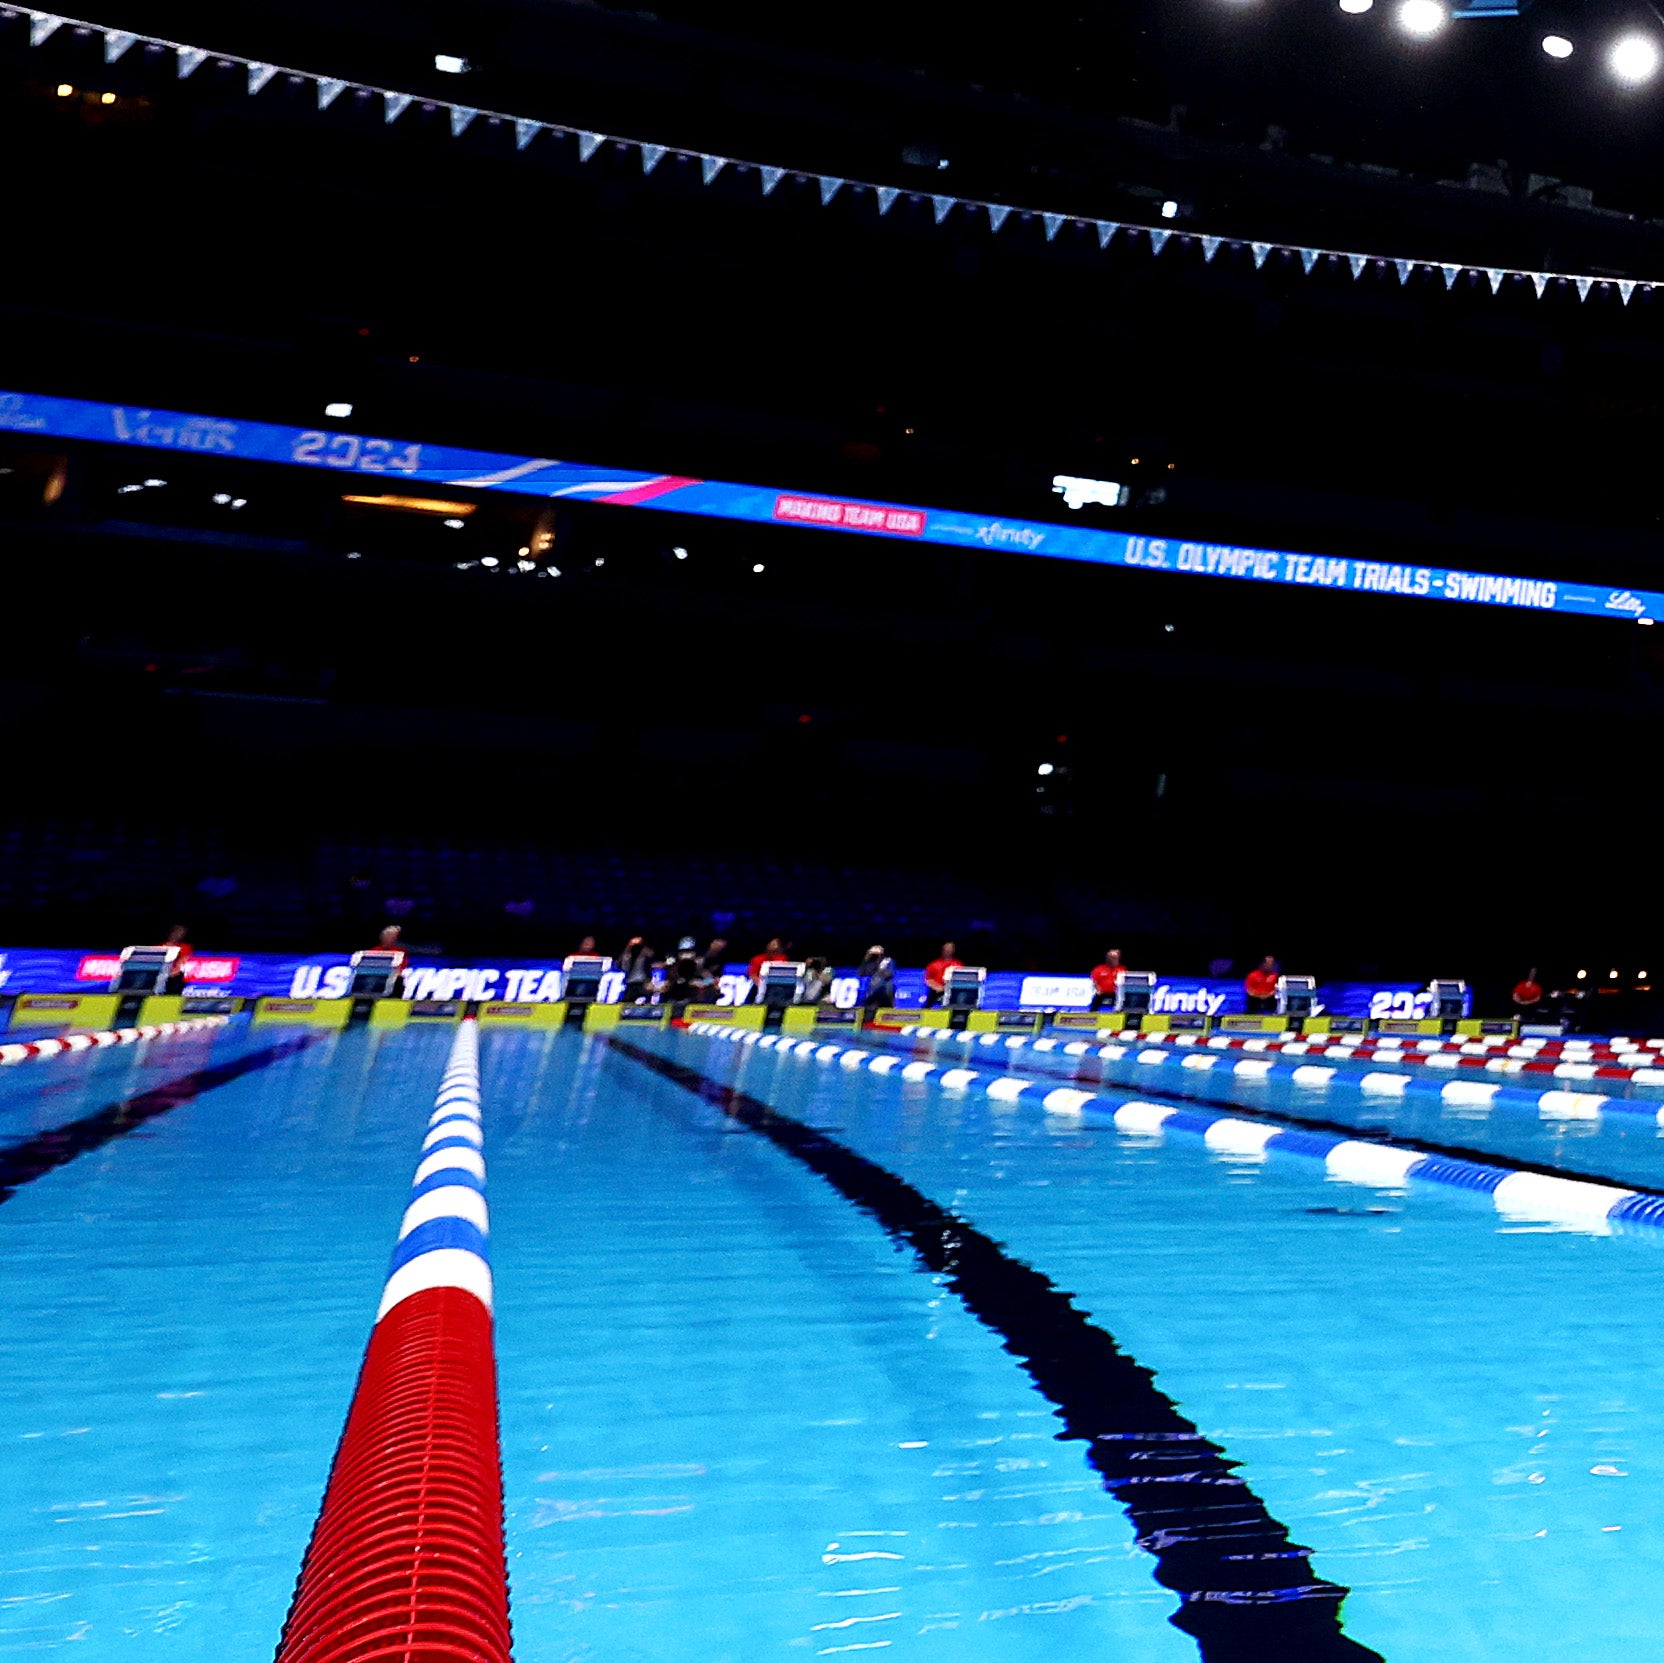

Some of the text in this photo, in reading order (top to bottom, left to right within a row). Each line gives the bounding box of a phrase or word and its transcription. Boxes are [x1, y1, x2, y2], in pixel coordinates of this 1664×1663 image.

[1125, 536, 1170, 568] U.S.
[1177, 540, 1278, 581] OLYMPIC
[1285, 550, 1348, 588] TEAM
[401, 967, 500, 1001] YMPIC
[504, 969, 564, 1003] TEA
[1153, 984, 1226, 1016] finity
